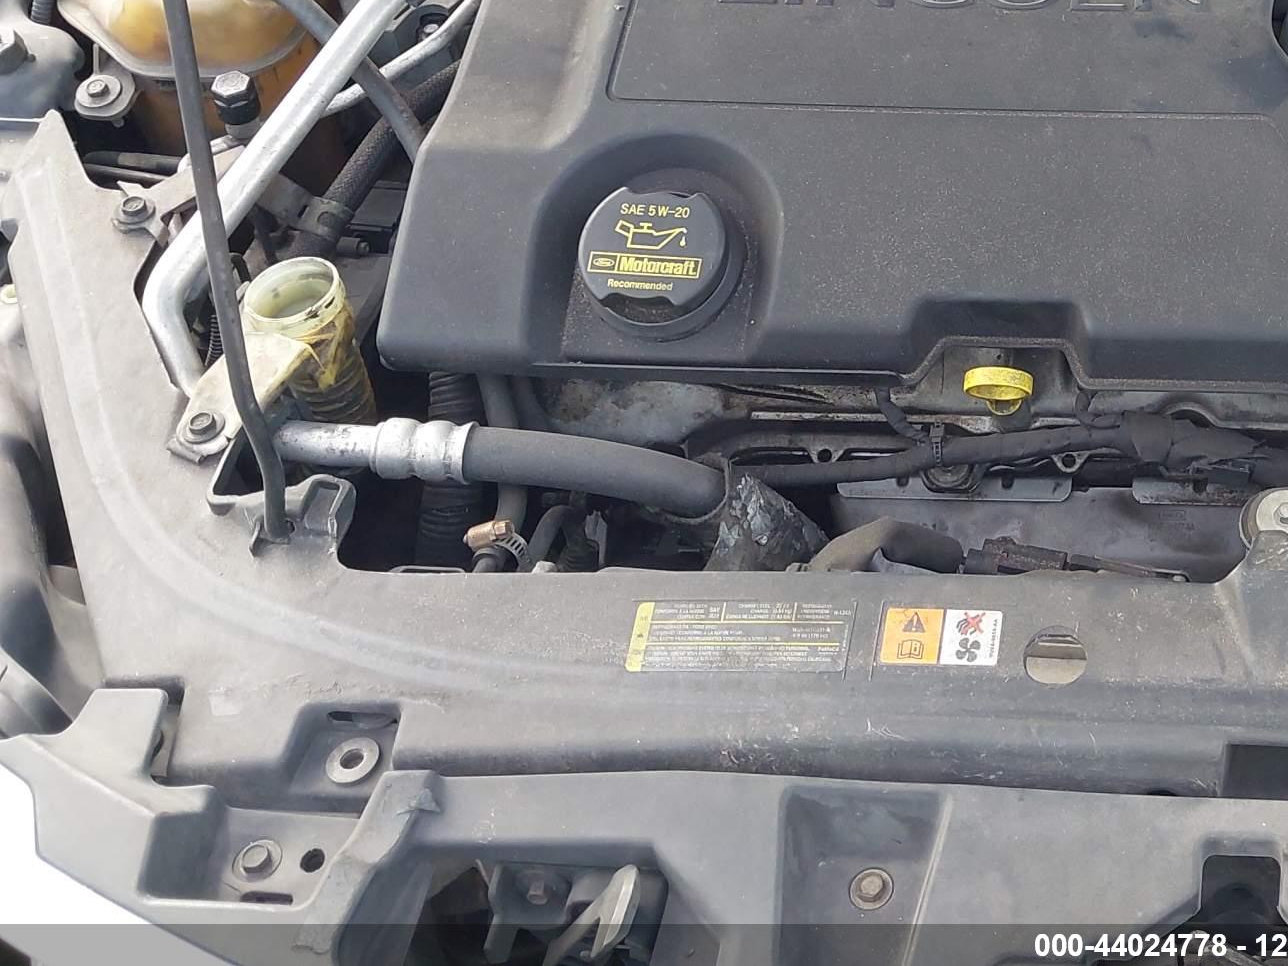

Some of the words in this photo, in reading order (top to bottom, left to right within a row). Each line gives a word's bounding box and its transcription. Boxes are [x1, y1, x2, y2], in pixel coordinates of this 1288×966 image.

[620, 203, 645, 216] SAE
[619, 256, 696, 275] Motorcraft
[607, 278, 673, 290] Recommended
